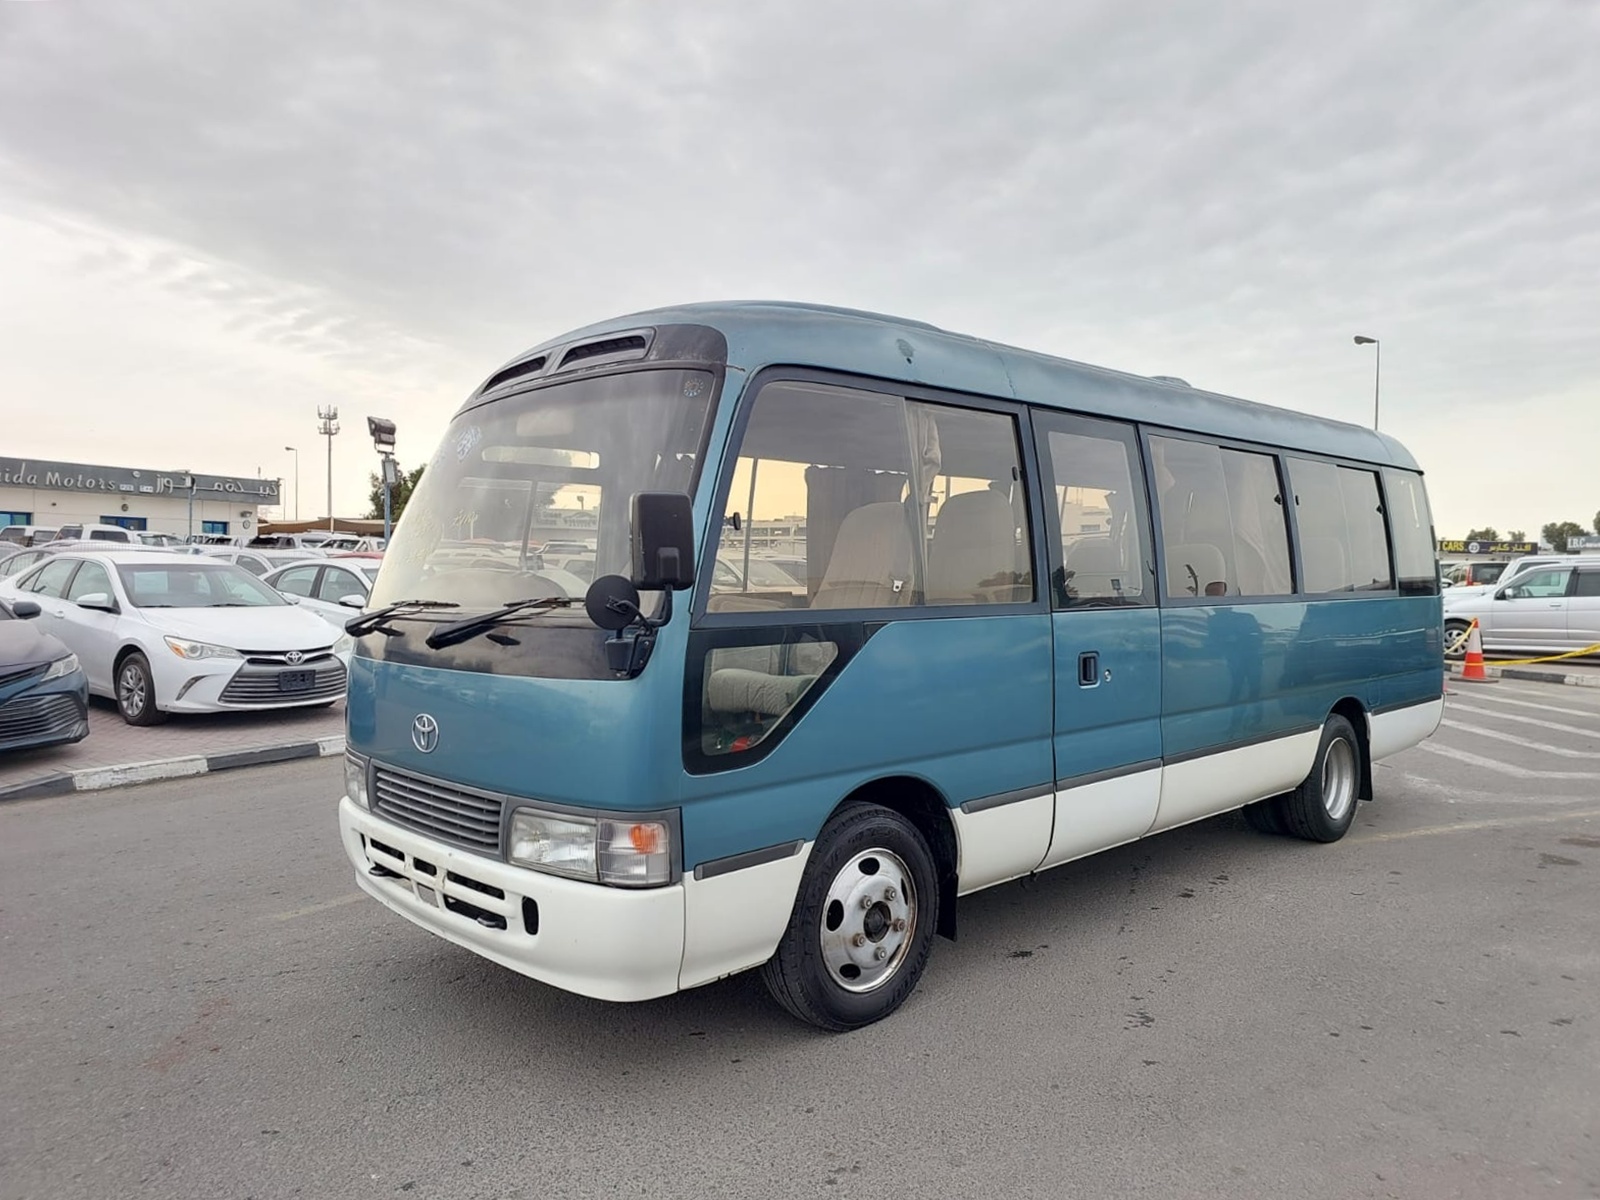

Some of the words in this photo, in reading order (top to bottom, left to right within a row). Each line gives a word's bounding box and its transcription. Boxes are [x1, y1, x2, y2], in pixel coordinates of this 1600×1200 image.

[0, 461, 37, 485] ida
[45, 471, 116, 491] Motors
[1442, 541, 1464, 551] CARS
